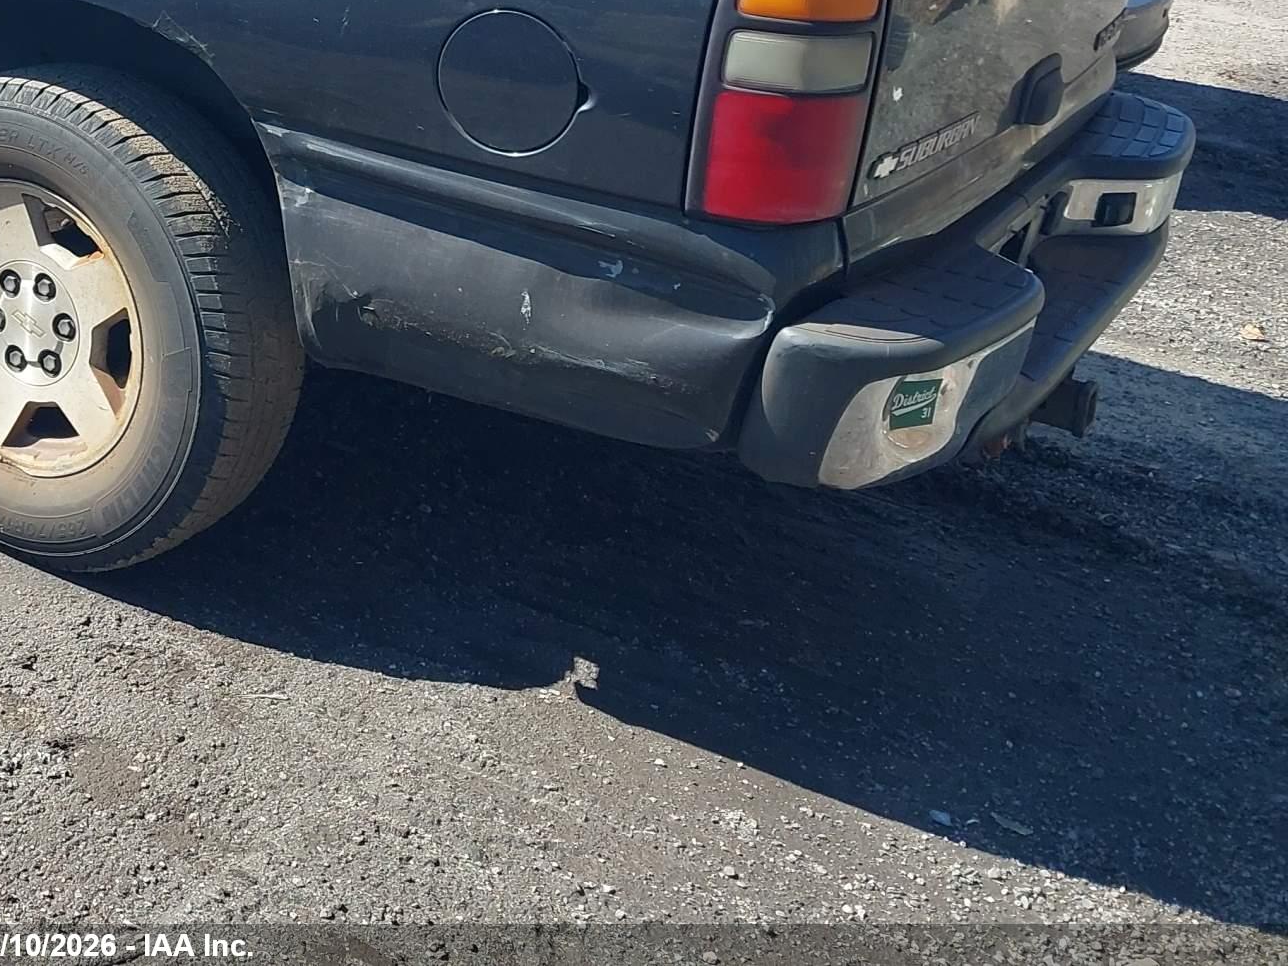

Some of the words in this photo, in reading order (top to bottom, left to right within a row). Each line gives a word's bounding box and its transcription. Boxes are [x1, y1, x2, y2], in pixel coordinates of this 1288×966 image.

[27, 134, 63, 160] LTX
[896, 115, 981, 171] SUBURBAN
[892, 386, 936, 412] District
[921, 409, 932, 420] 31
